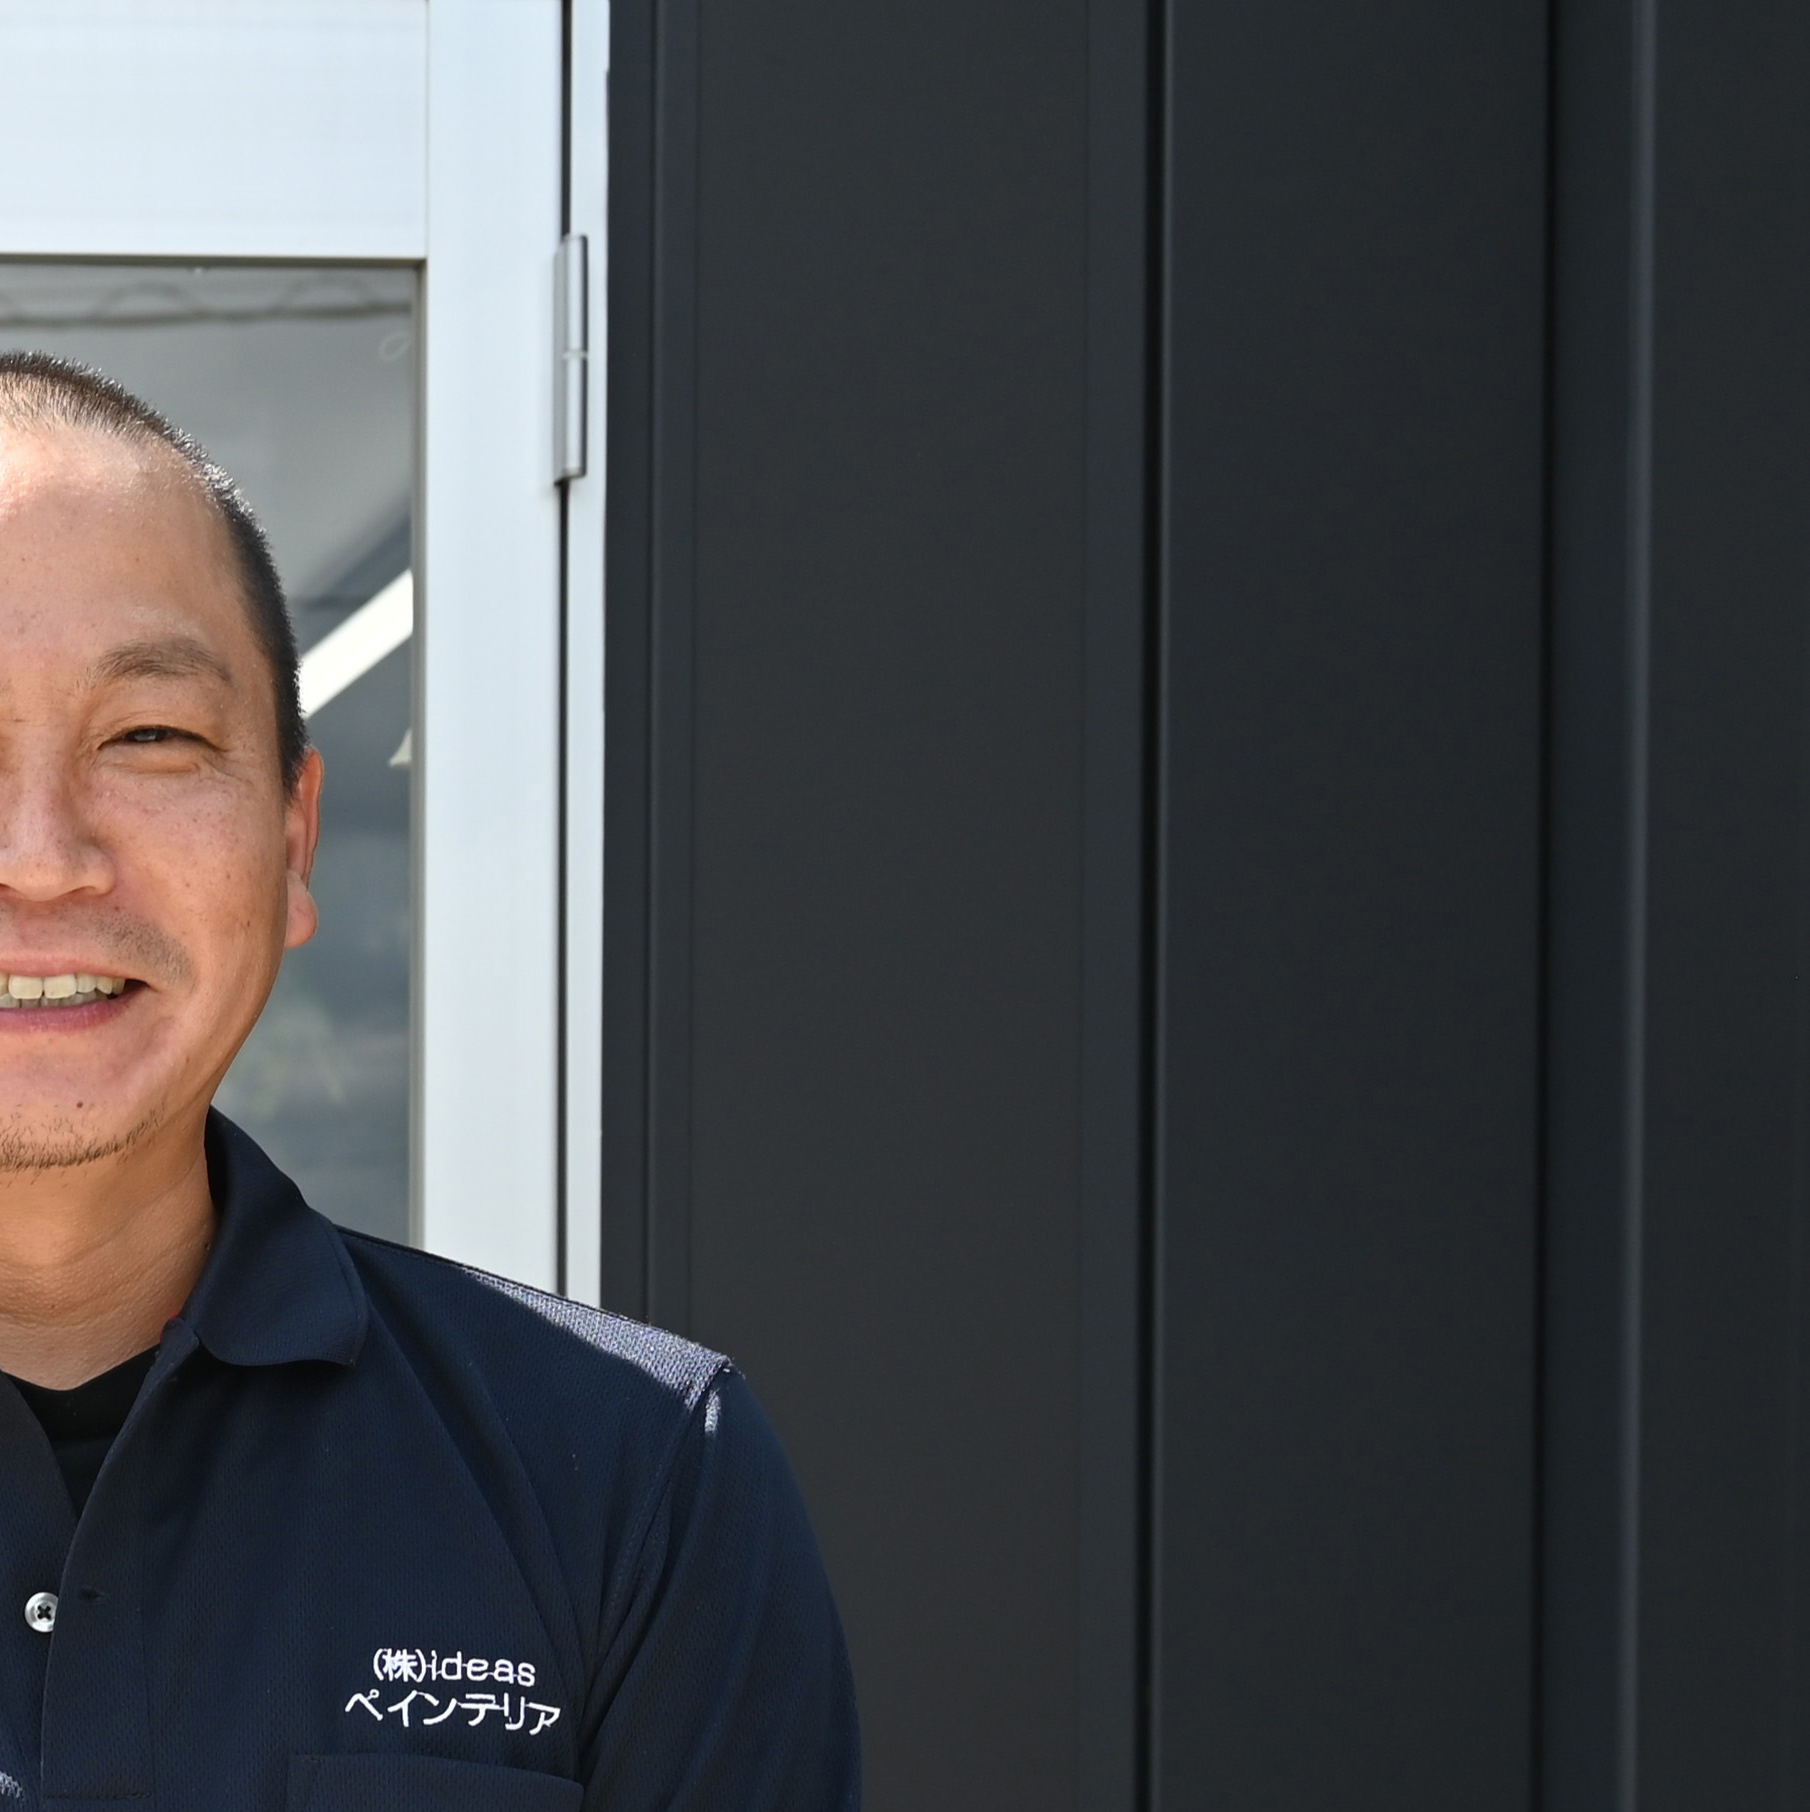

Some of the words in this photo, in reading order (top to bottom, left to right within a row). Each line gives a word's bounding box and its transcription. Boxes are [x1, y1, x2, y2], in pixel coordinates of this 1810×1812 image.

[344, 1688, 561, 1736] ペインテリア
